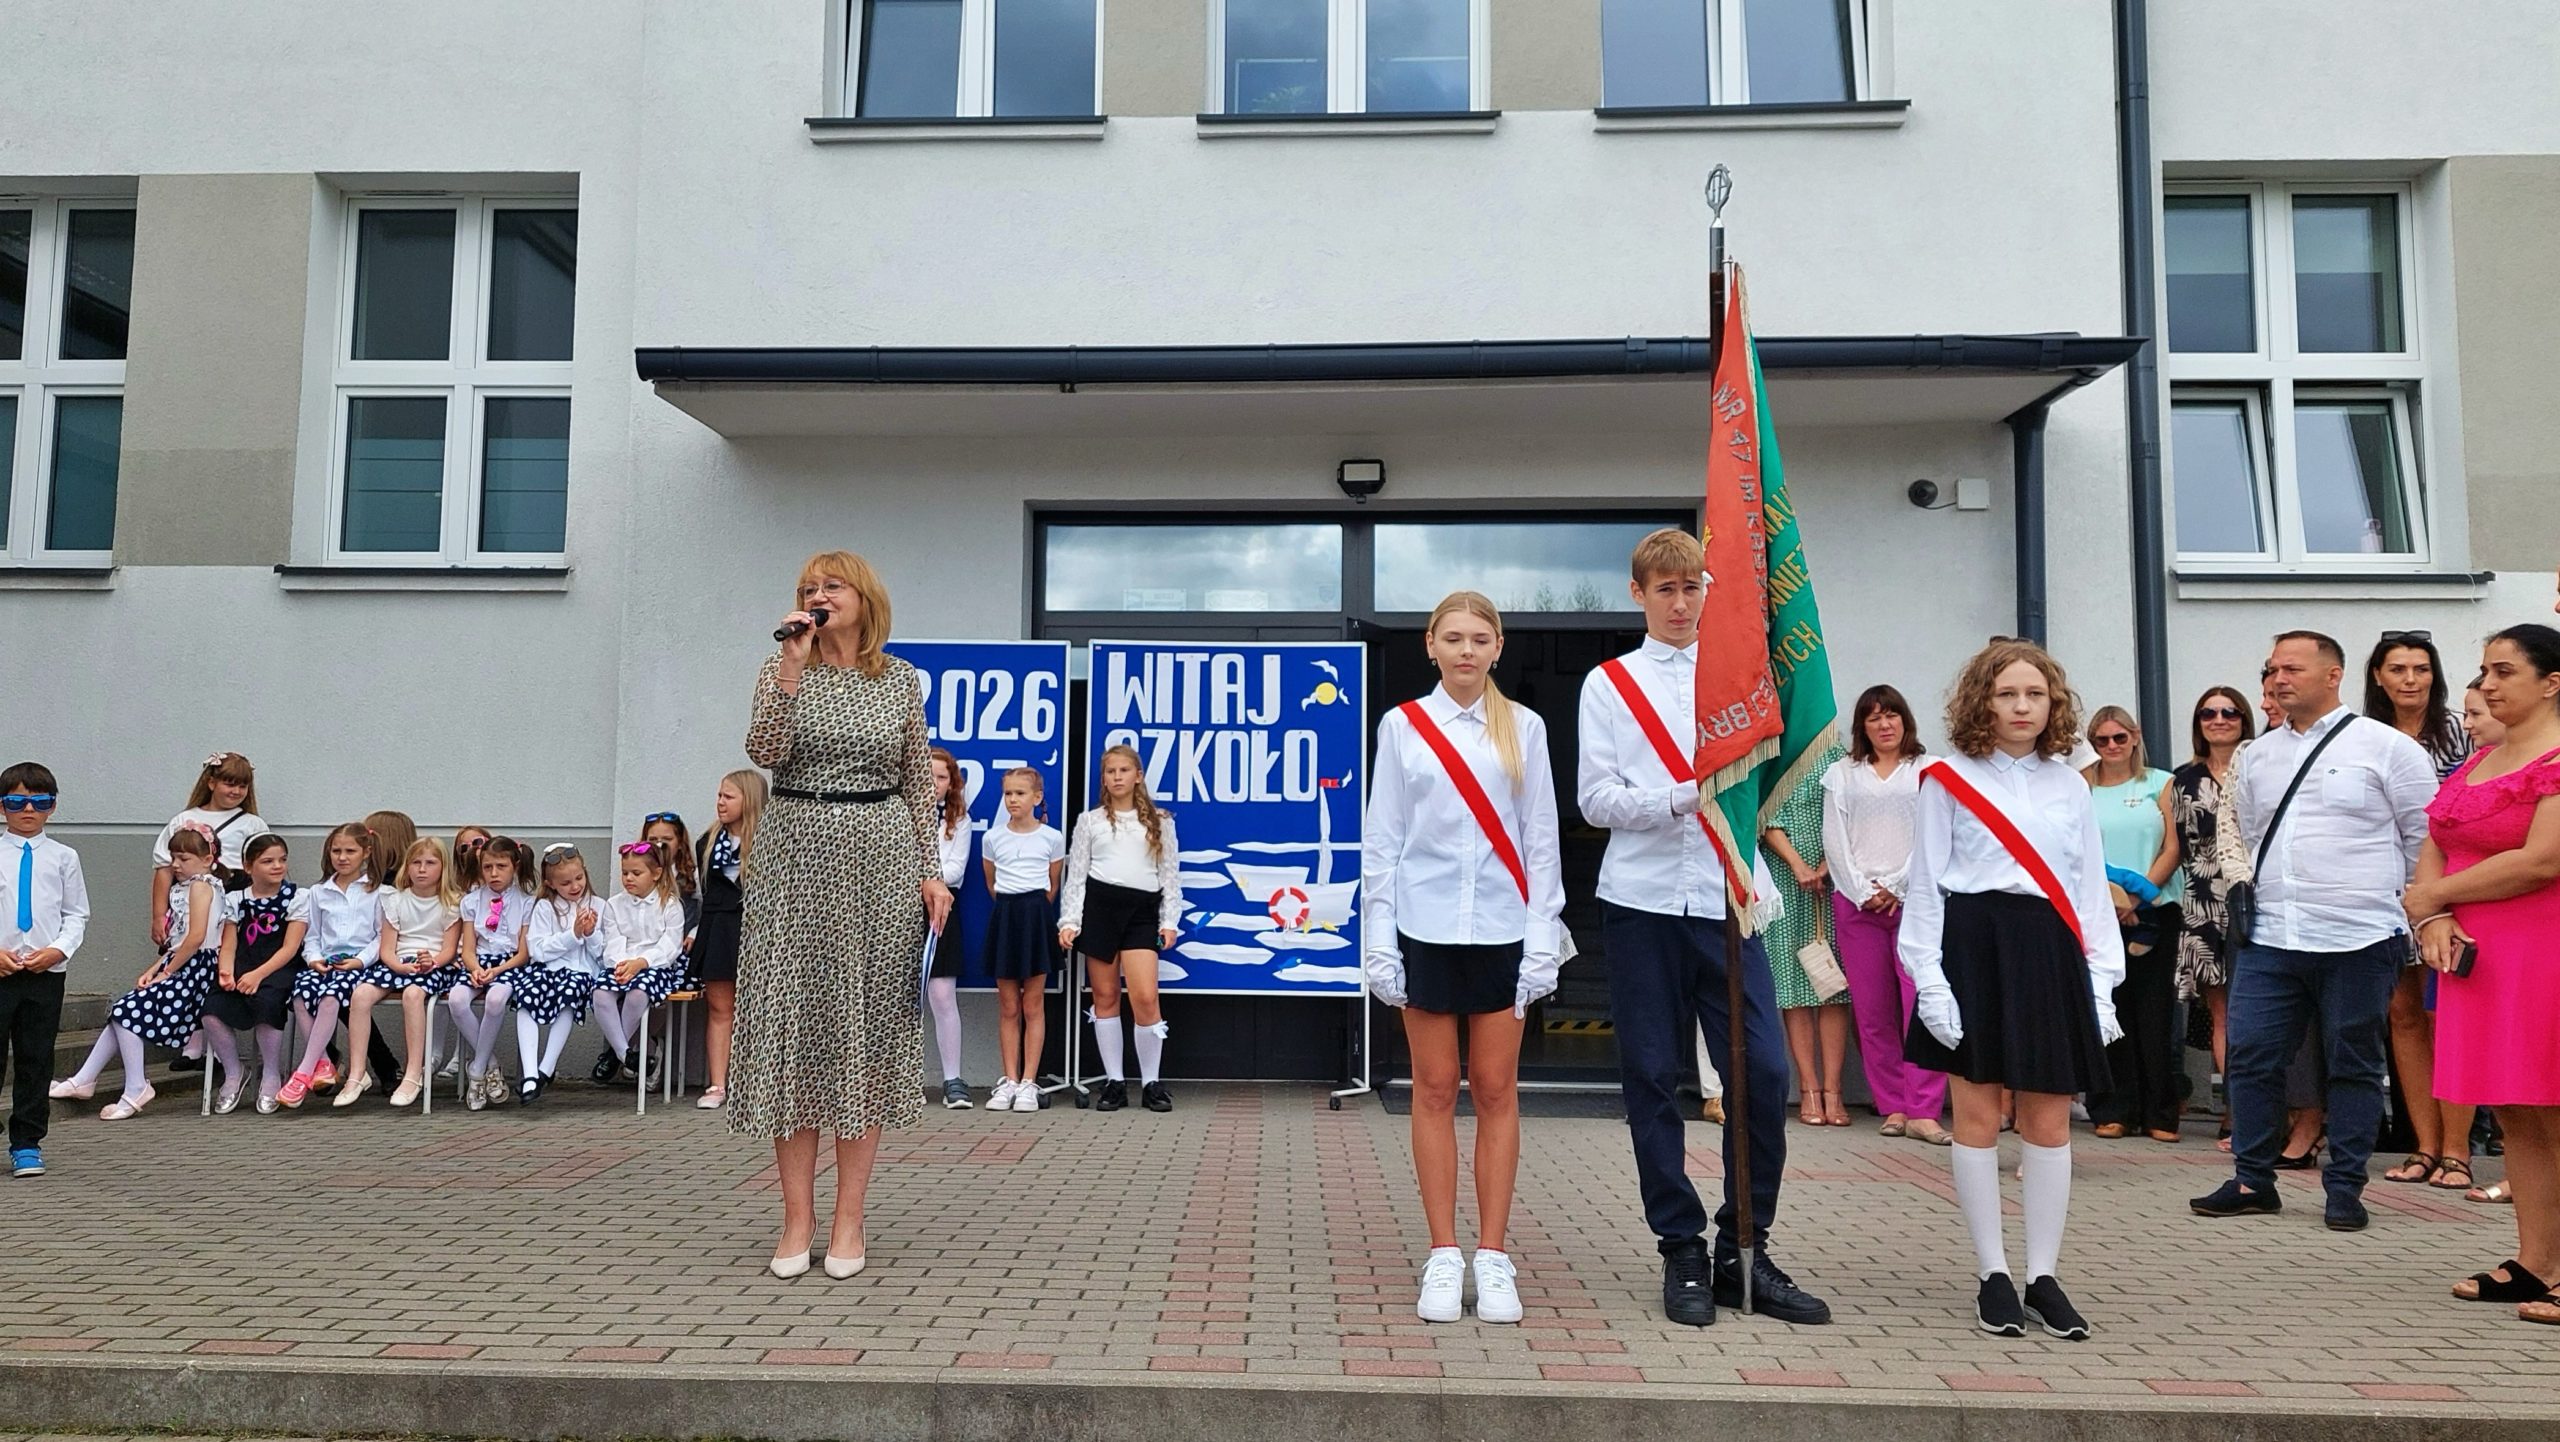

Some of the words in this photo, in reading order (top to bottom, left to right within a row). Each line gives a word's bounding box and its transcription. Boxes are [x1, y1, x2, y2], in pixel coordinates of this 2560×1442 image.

[1713, 381, 1746, 424] NR
[1729, 428, 1752, 463] 47
[1739, 474, 1758, 502] IM
[1107, 652, 1281, 725] WITAJ
[1696, 701, 1752, 750] BRY
[1104, 728, 1318, 802] ZKOŁO
